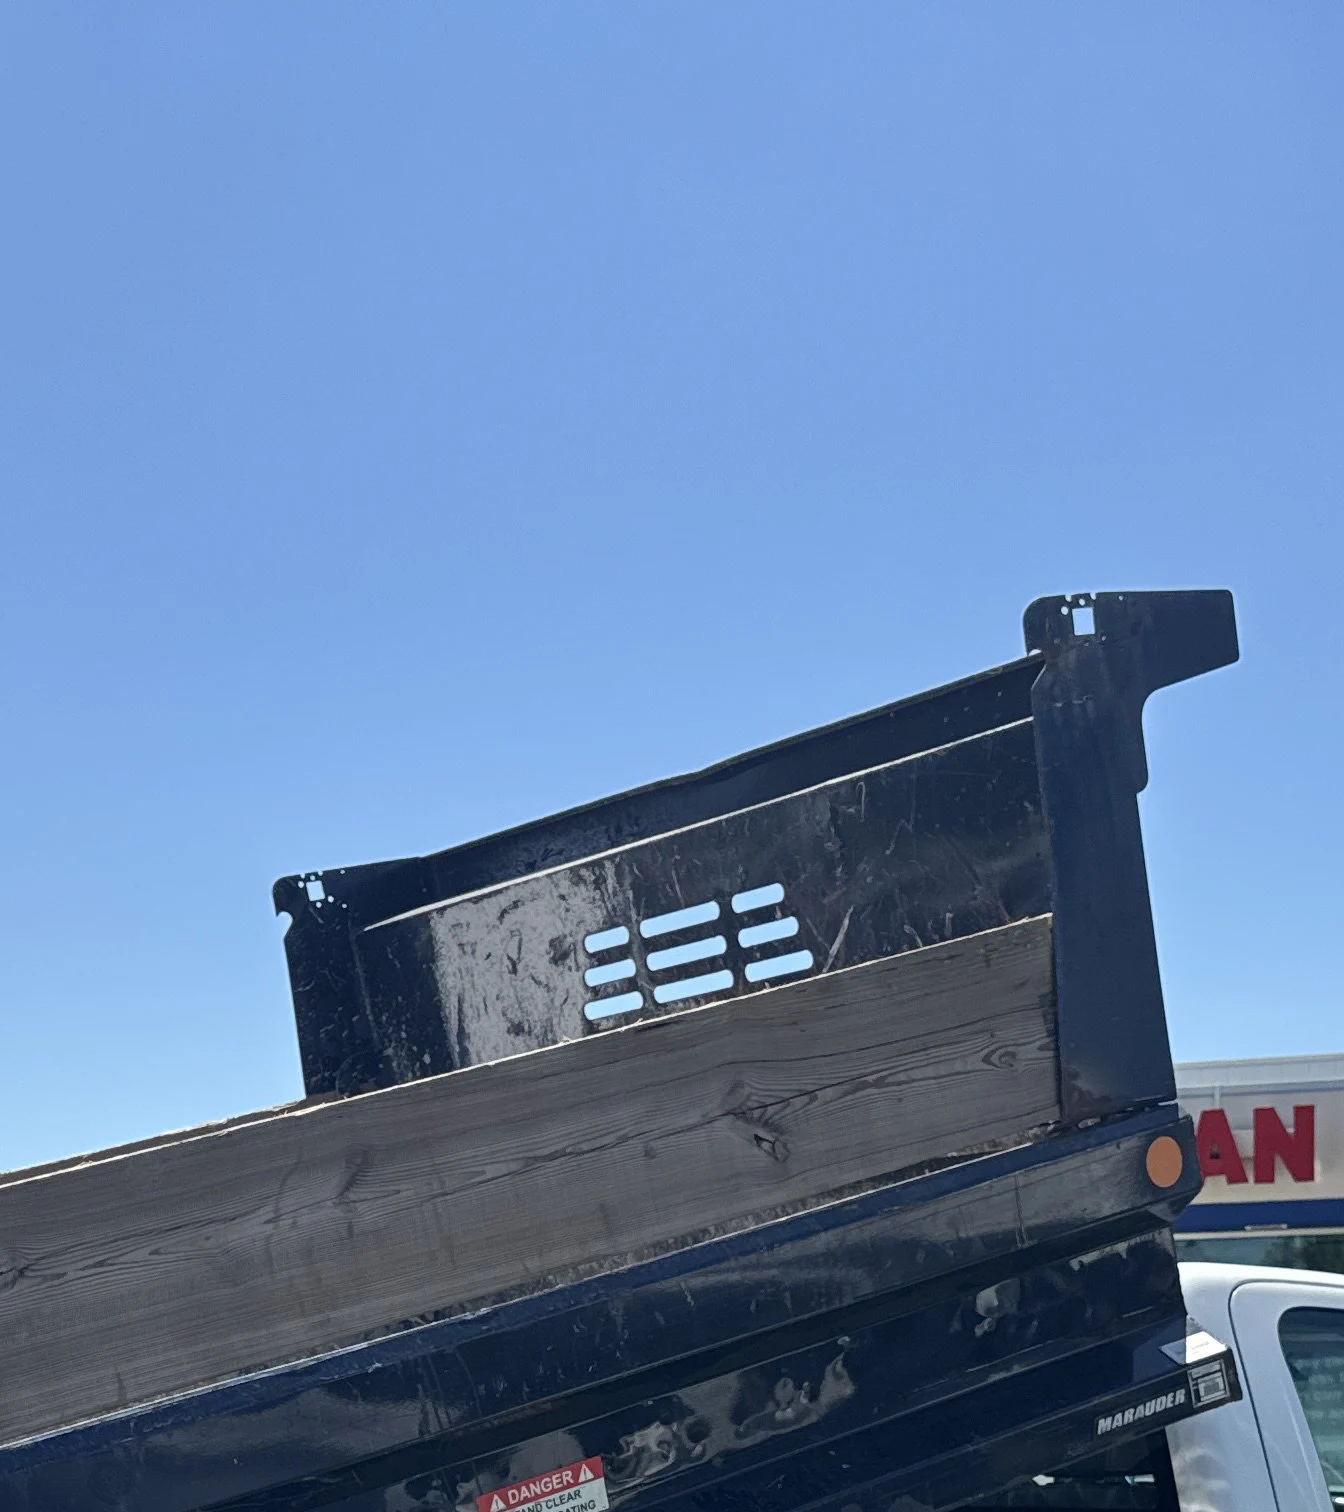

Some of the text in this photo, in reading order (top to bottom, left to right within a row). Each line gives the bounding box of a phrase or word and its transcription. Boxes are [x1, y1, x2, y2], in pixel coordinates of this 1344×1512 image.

[1196, 1104, 1315, 1184] AN
[1097, 1388, 1186, 1435] MARAUDER
[507, 1470, 574, 1504] DANGER
[545, 1489, 582, 1510] CLEAR
